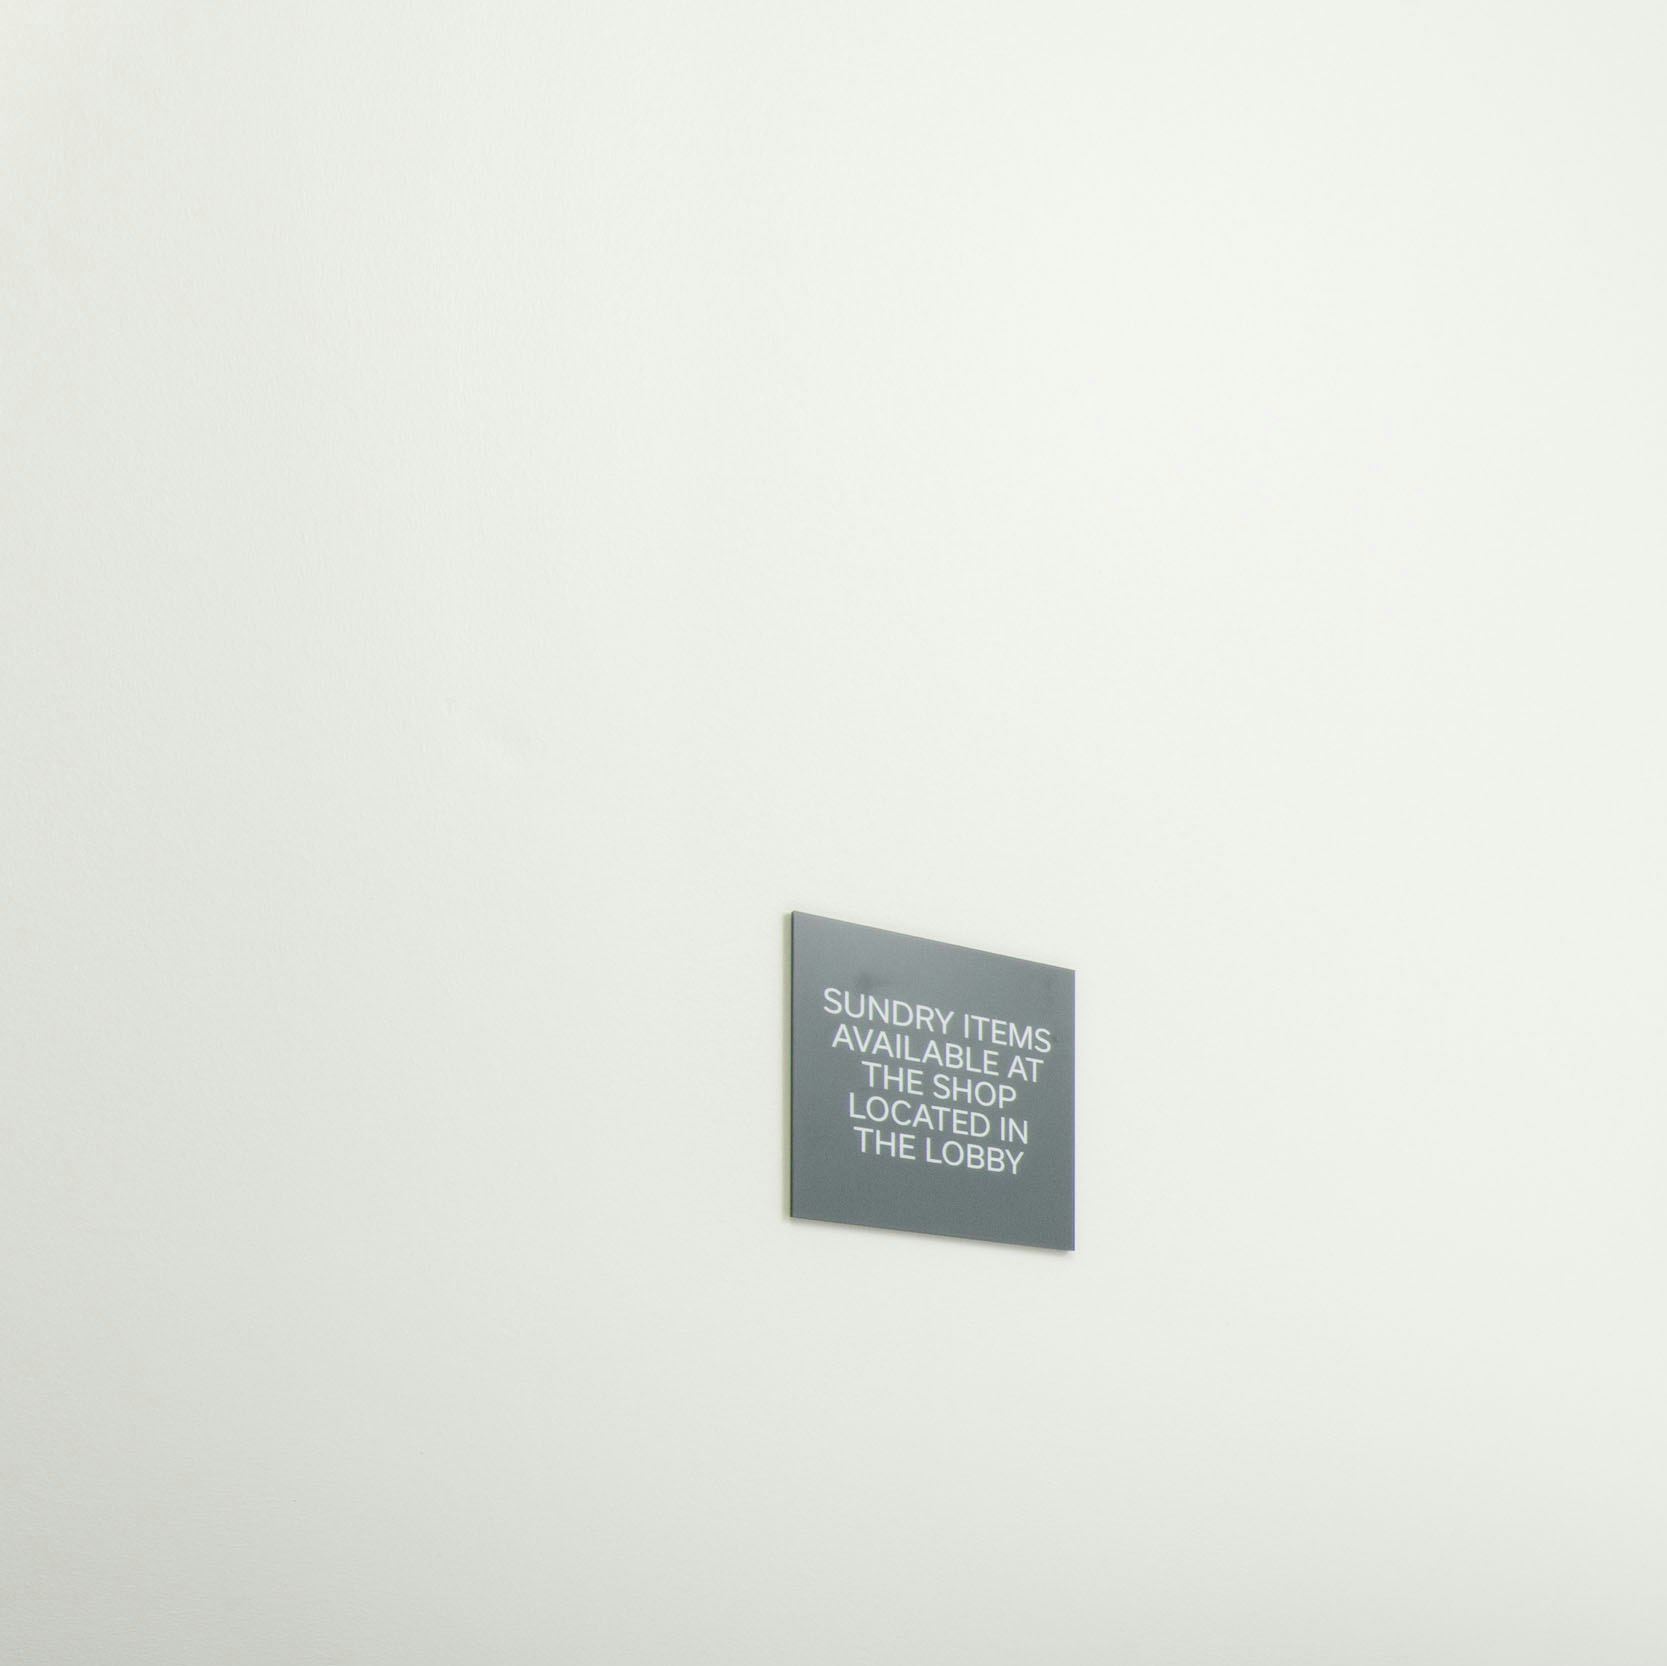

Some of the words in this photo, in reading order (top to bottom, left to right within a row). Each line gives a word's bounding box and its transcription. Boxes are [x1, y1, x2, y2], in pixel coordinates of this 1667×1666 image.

[823, 986, 954, 1034] SUNDRY
[964, 1013, 1052, 1054] ITEMS
[831, 1023, 1000, 1077] AVAILABLE
[1007, 1056, 1044, 1083] AT
[861, 1060, 924, 1096] THE
[932, 1074, 1016, 1109] SHOP
[849, 1092, 990, 1138] LOCATED
[1000, 1116, 1028, 1145] IN
[853, 1126, 916, 1160] THE
[926, 1137, 1024, 1175] LOBBY
